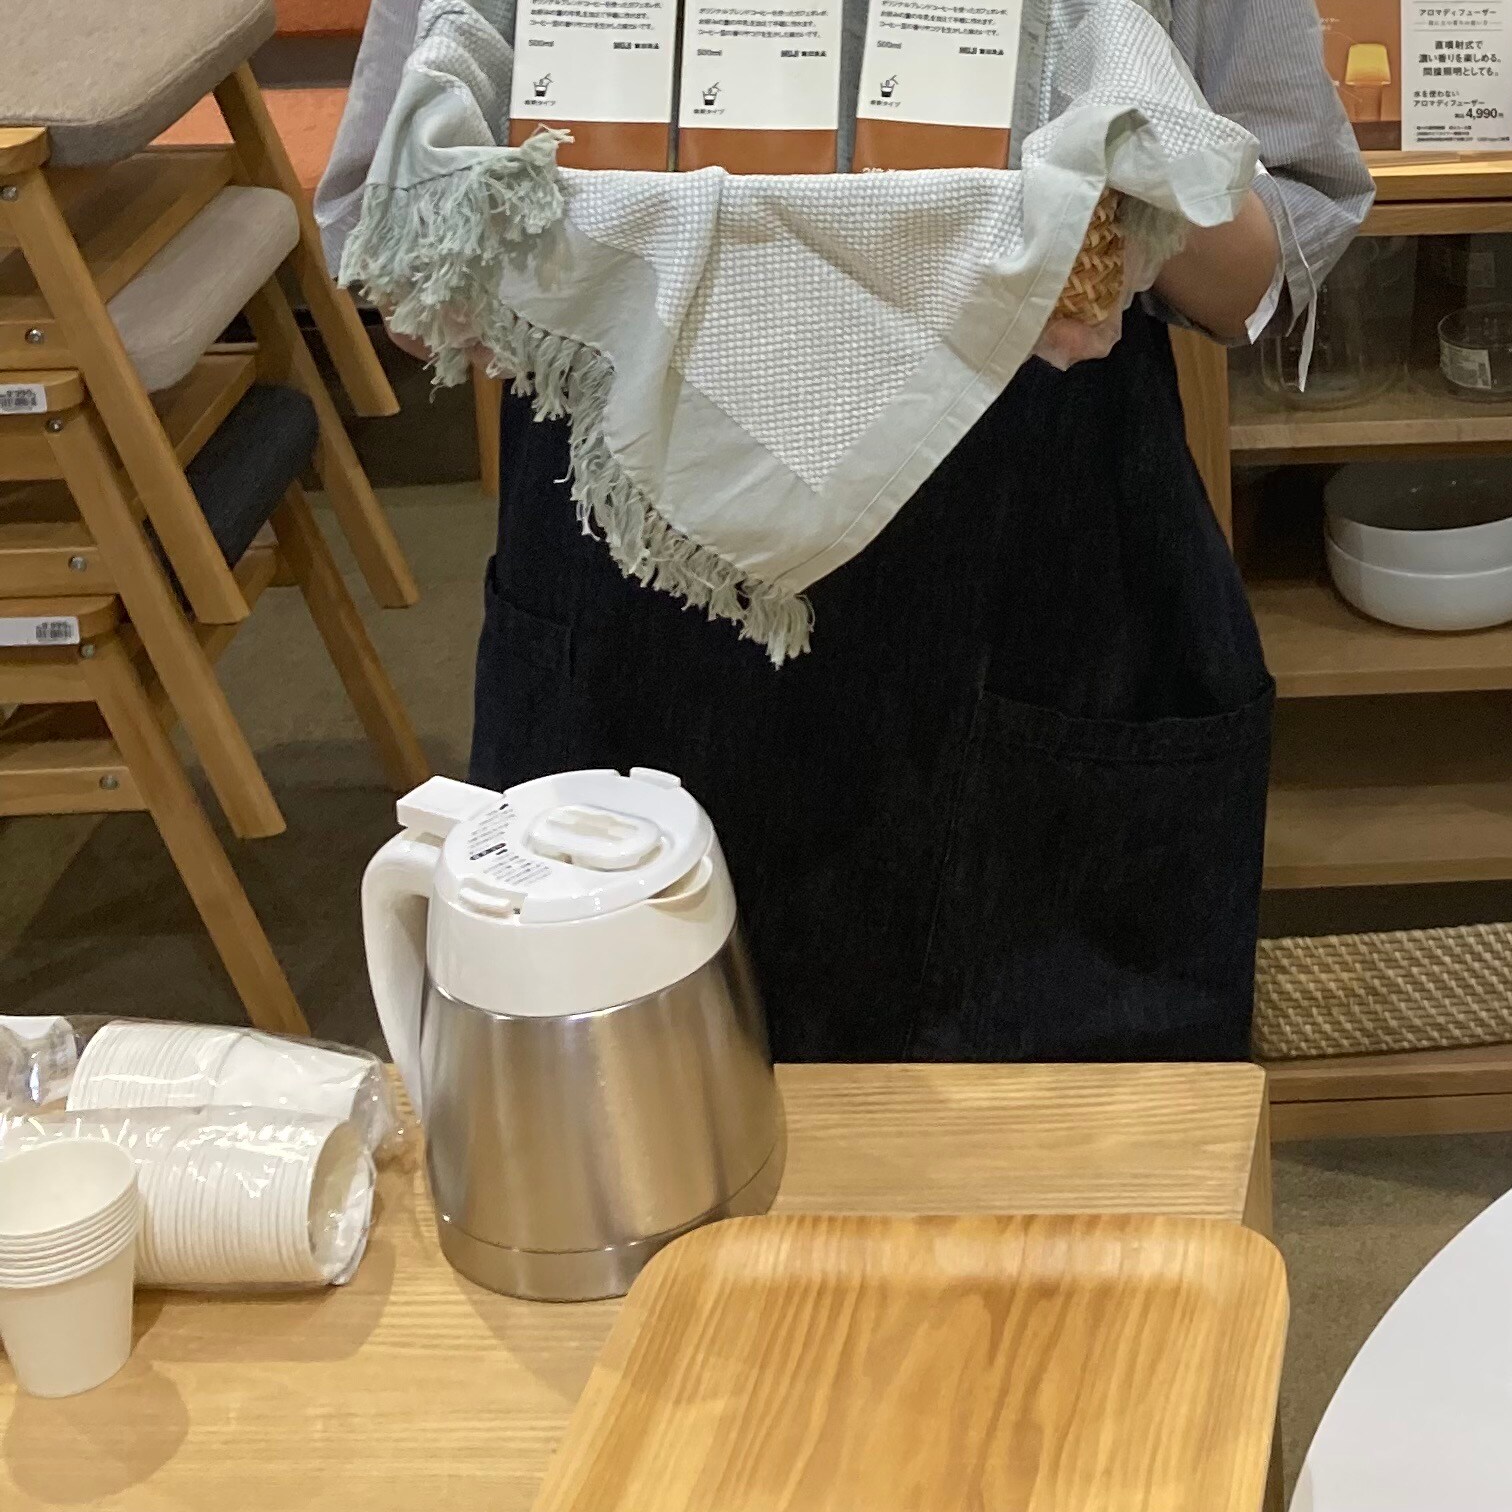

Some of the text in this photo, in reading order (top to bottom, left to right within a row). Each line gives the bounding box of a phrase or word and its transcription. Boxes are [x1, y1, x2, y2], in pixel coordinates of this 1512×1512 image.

[1419, 8, 1497, 17] アロマディフューザー
[1435, 40, 1483, 50] 直噴射式で
[1418, 53, 1501, 64] 濃い香りを楽しめる。
[1422, 66, 1499, 77] 間接照明としても。
[1413, 90, 1460, 98] 水を使わない
[1413, 99, 1485, 107] アロマディフューザー
